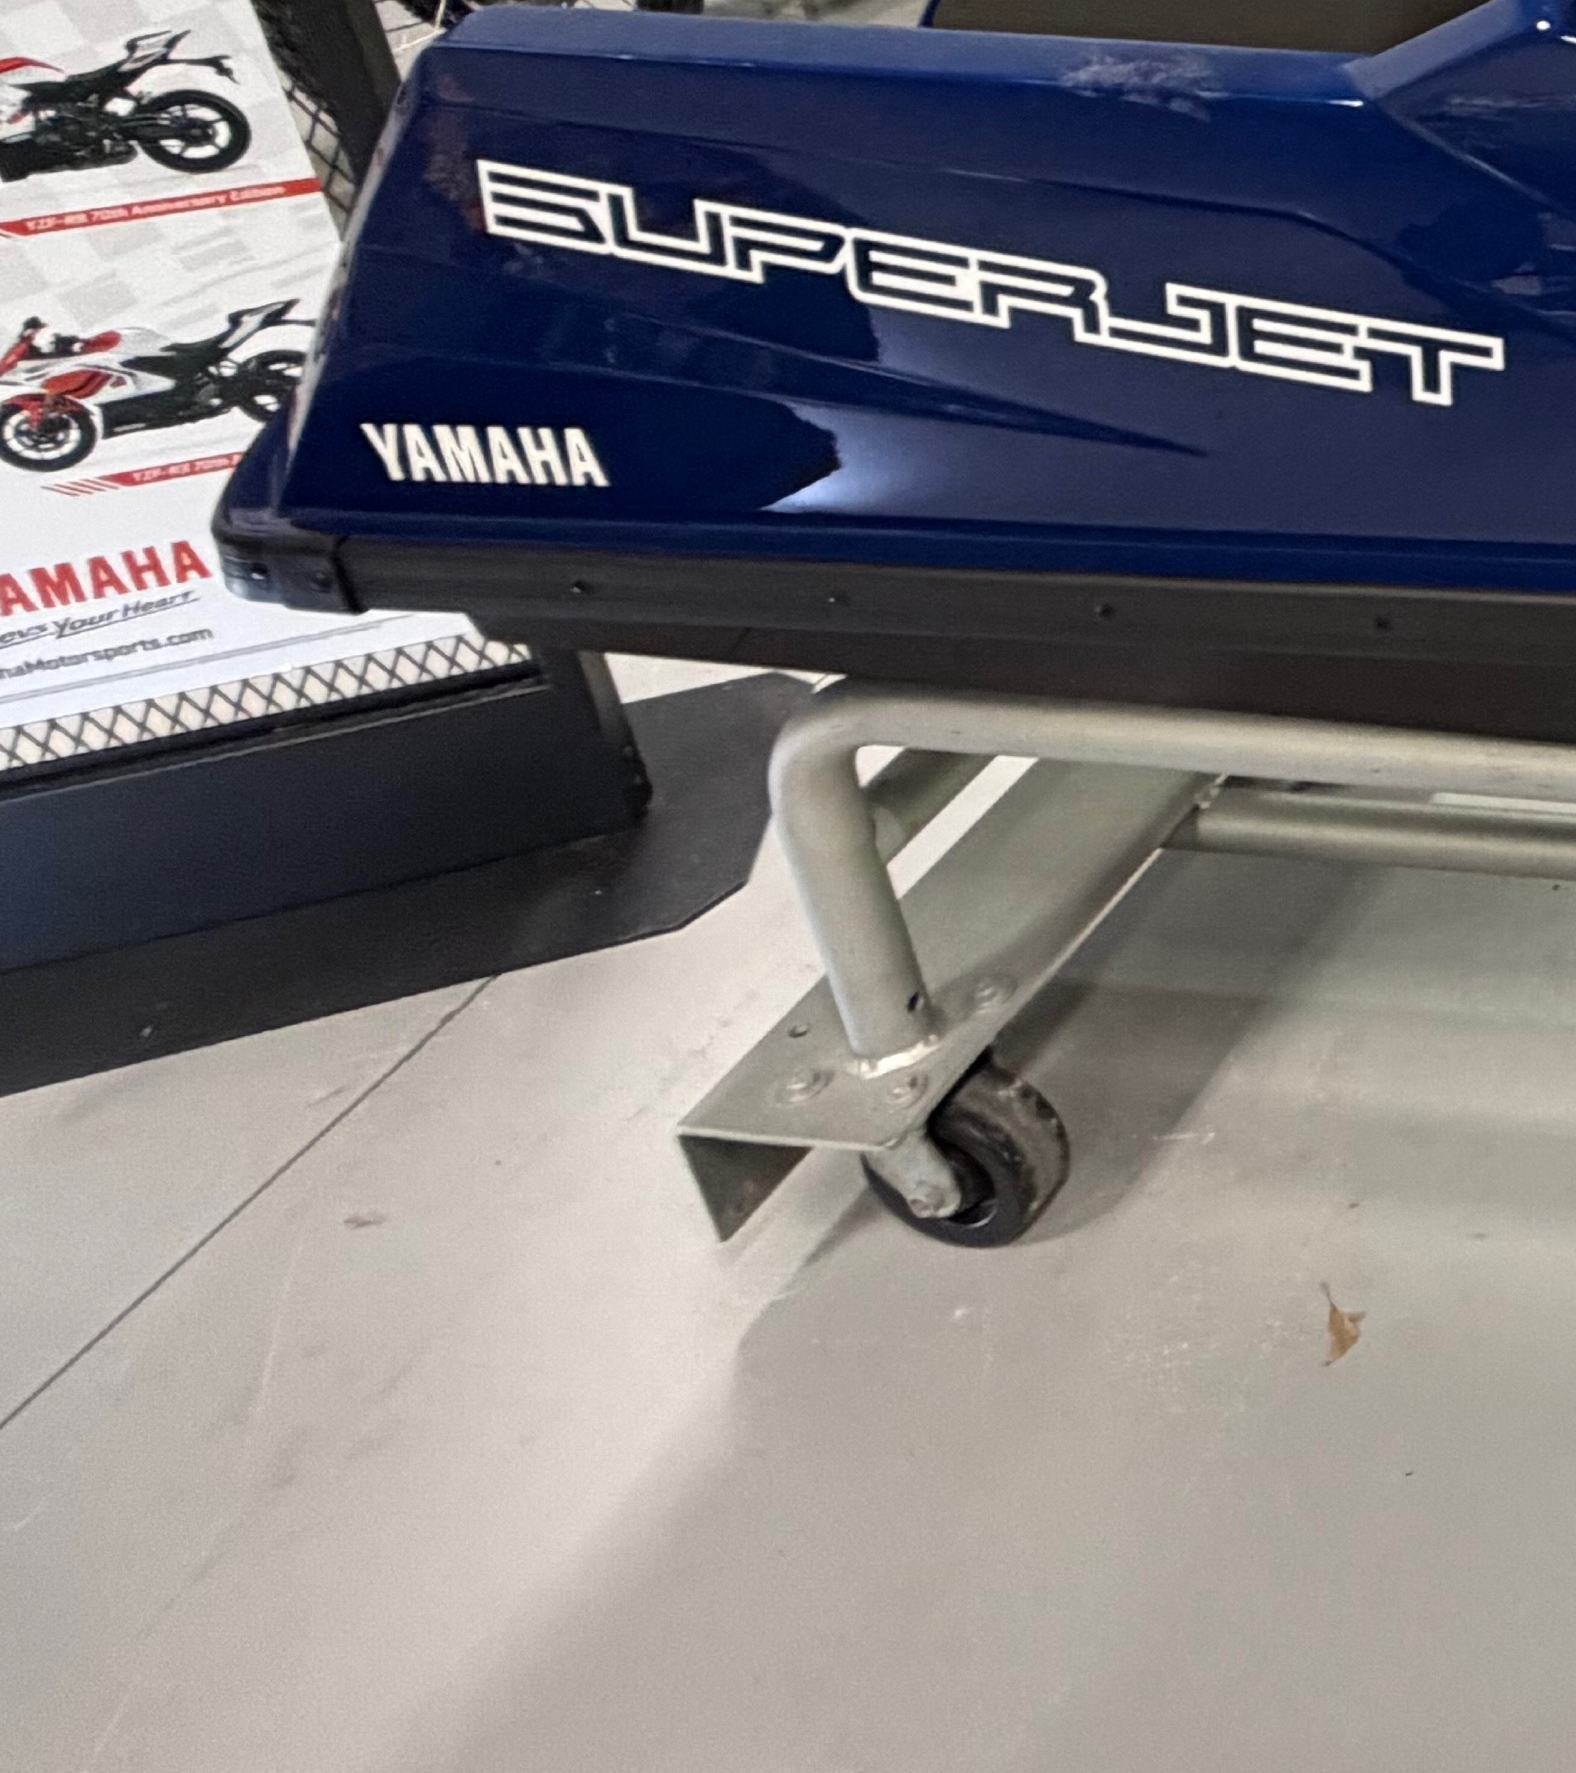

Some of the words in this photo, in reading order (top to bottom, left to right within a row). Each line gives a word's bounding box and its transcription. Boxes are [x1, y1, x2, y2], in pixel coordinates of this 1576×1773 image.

[477, 159, 1504, 406] SUPERJET
[361, 422, 610, 487] YAMAHA
[0, 540, 213, 617] AMAHA
[52, 608, 119, 638] Your
[122, 590, 195, 618] Heart
